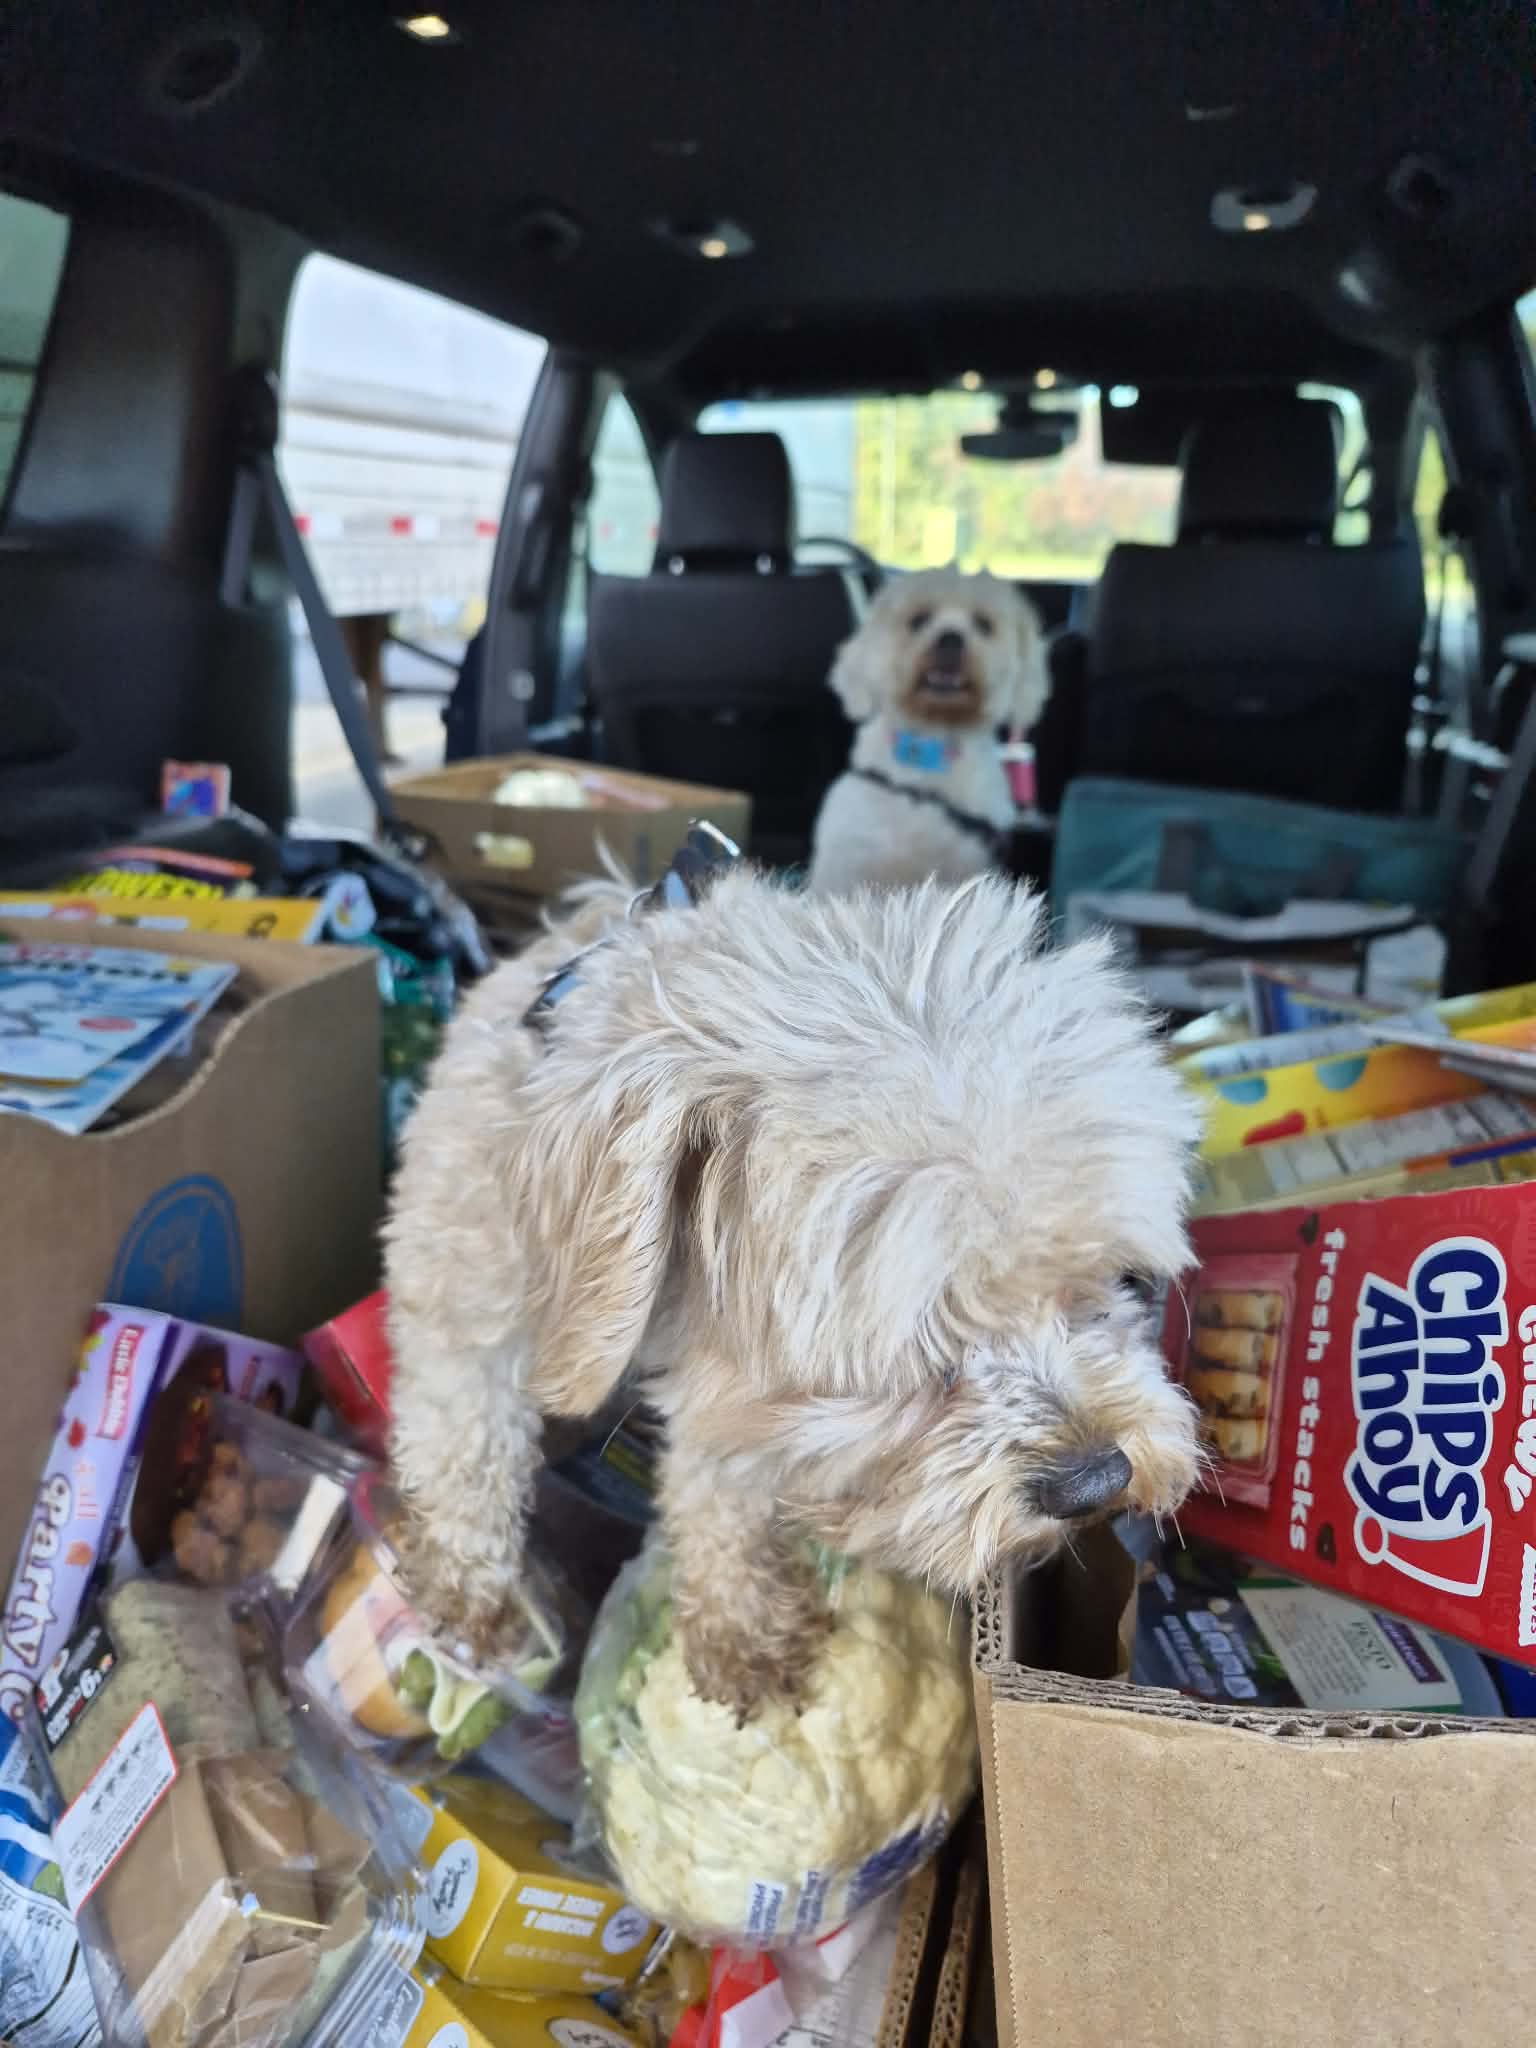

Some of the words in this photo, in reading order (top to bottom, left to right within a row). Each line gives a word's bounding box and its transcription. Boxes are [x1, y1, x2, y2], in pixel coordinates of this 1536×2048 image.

[1306, 1228, 1346, 1362] fresh
[1411, 1244, 1505, 1528] Chips
[1289, 1376, 1321, 1551] stacks
[5, 1472, 71, 1668] Party
